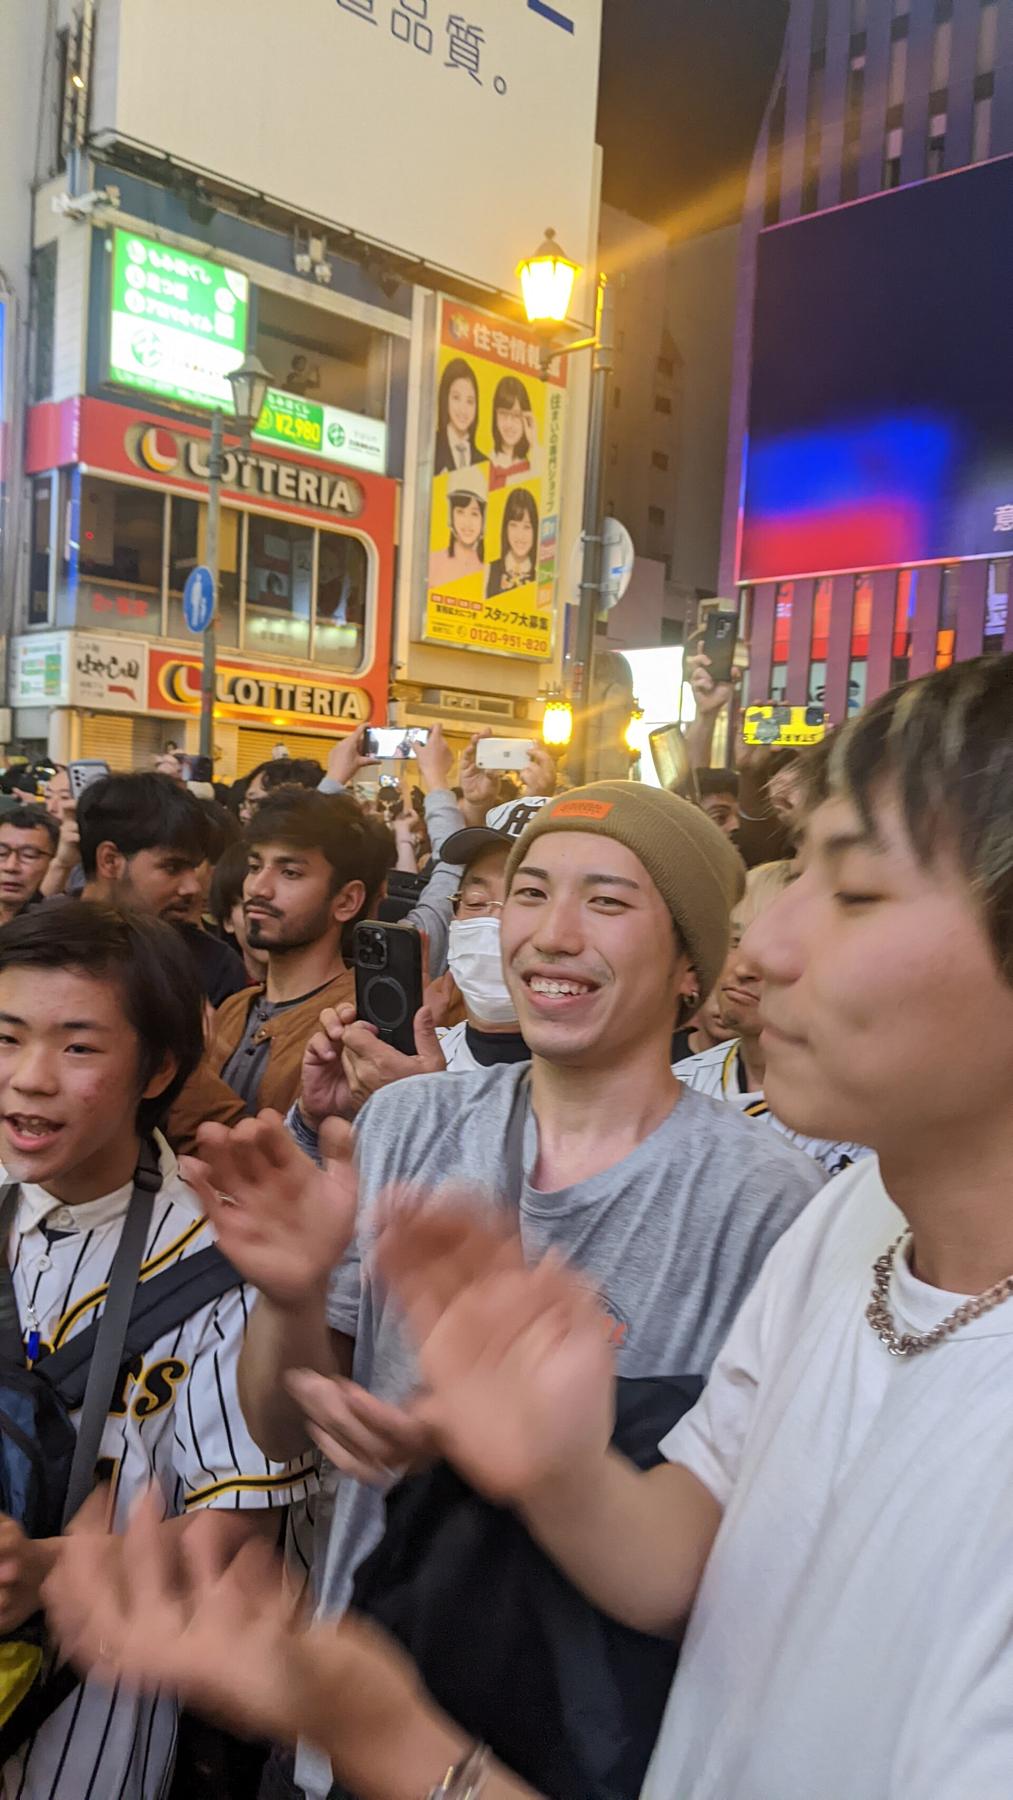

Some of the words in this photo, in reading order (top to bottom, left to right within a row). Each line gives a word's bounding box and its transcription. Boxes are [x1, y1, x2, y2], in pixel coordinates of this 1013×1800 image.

[189, 442, 354, 514] LOTTERIA
[469, 627, 547, 653] 0120-951-820
[216, 674, 362, 720] LOTTERIA
